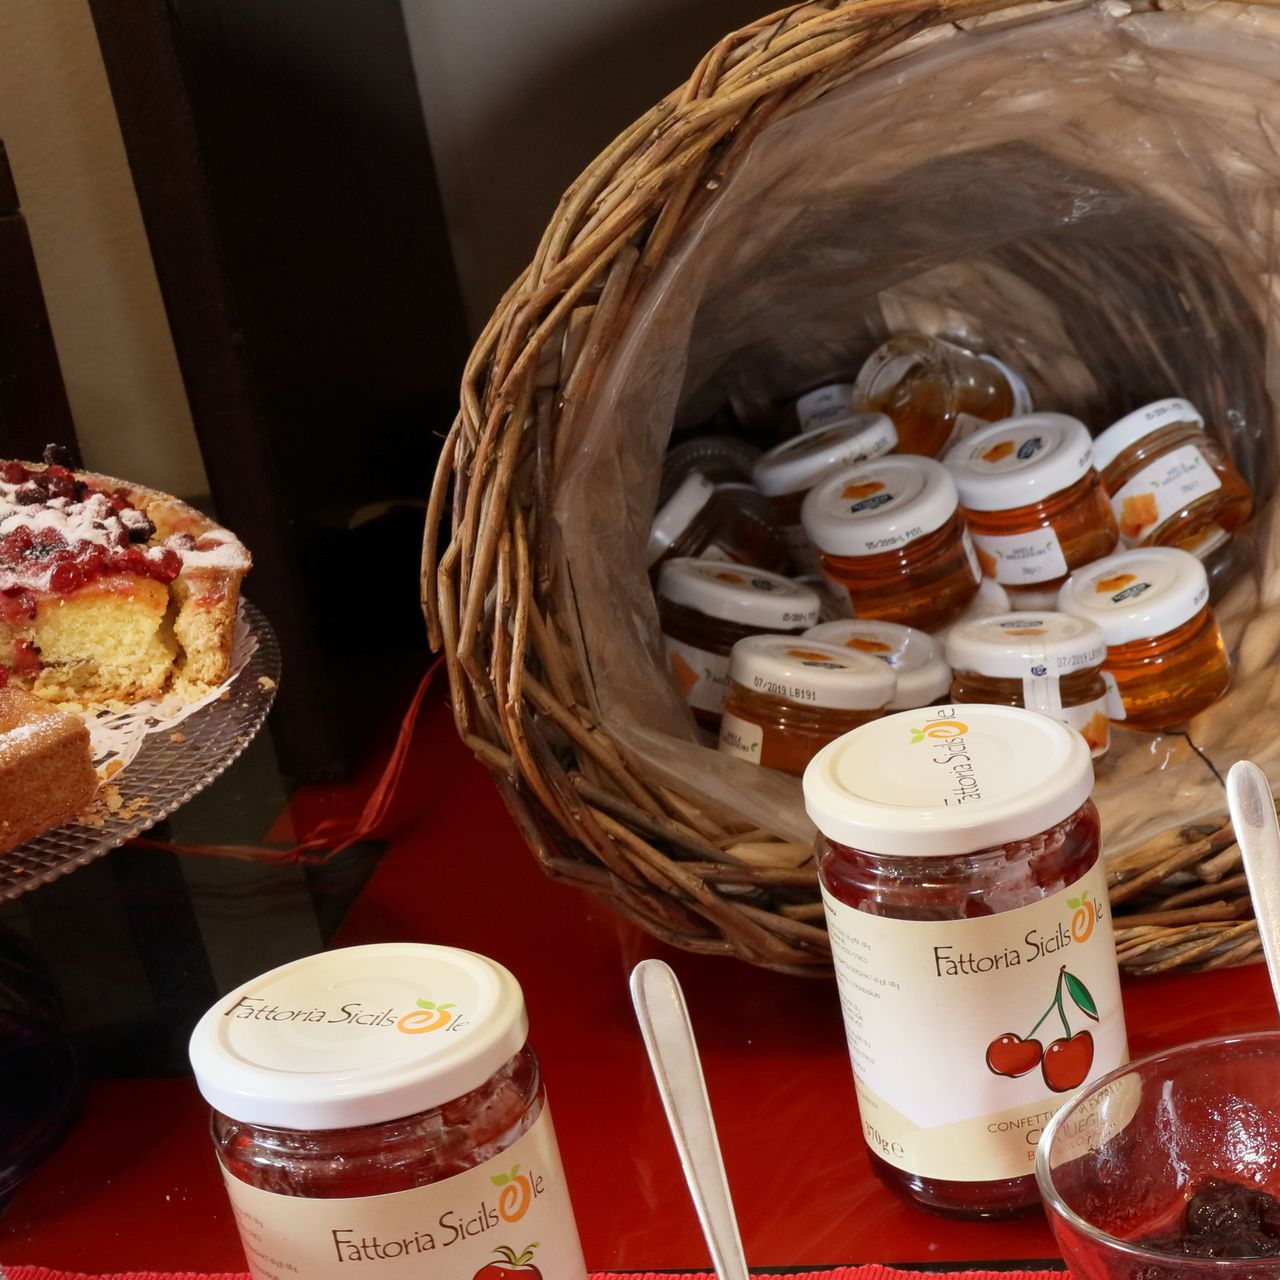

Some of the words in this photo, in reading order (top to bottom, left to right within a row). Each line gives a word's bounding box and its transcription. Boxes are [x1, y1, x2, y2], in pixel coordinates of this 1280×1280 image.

[754, 676, 787, 696] 07/2019
[933, 945, 1021, 977] Fattoria
[224, 995, 328, 1024] Fattoria
[331, 1229, 436, 1263] Fattoria
